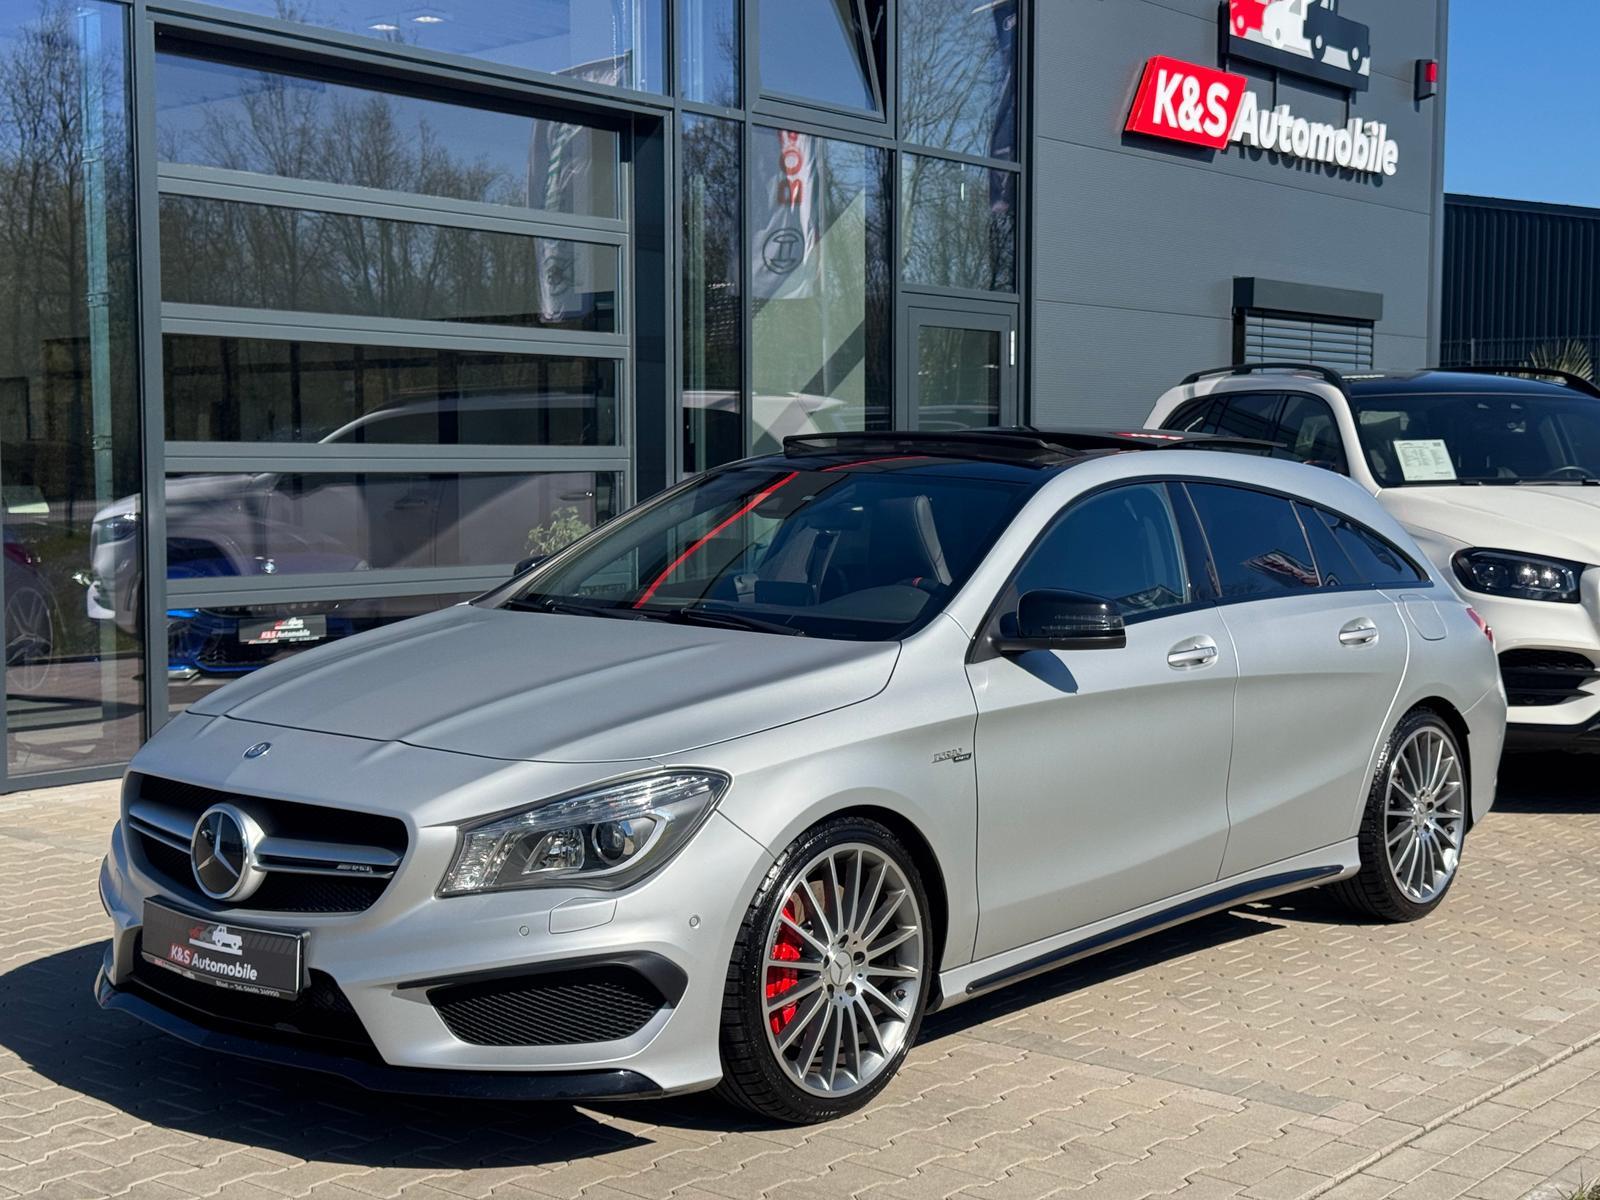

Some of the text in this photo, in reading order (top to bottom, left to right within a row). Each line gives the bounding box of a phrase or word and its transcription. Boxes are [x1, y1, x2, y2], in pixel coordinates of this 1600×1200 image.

[1152, 68, 1399, 176] K&S Automobile
[170, 944, 192, 965] K&S
[191, 952, 258, 981] Automobile
